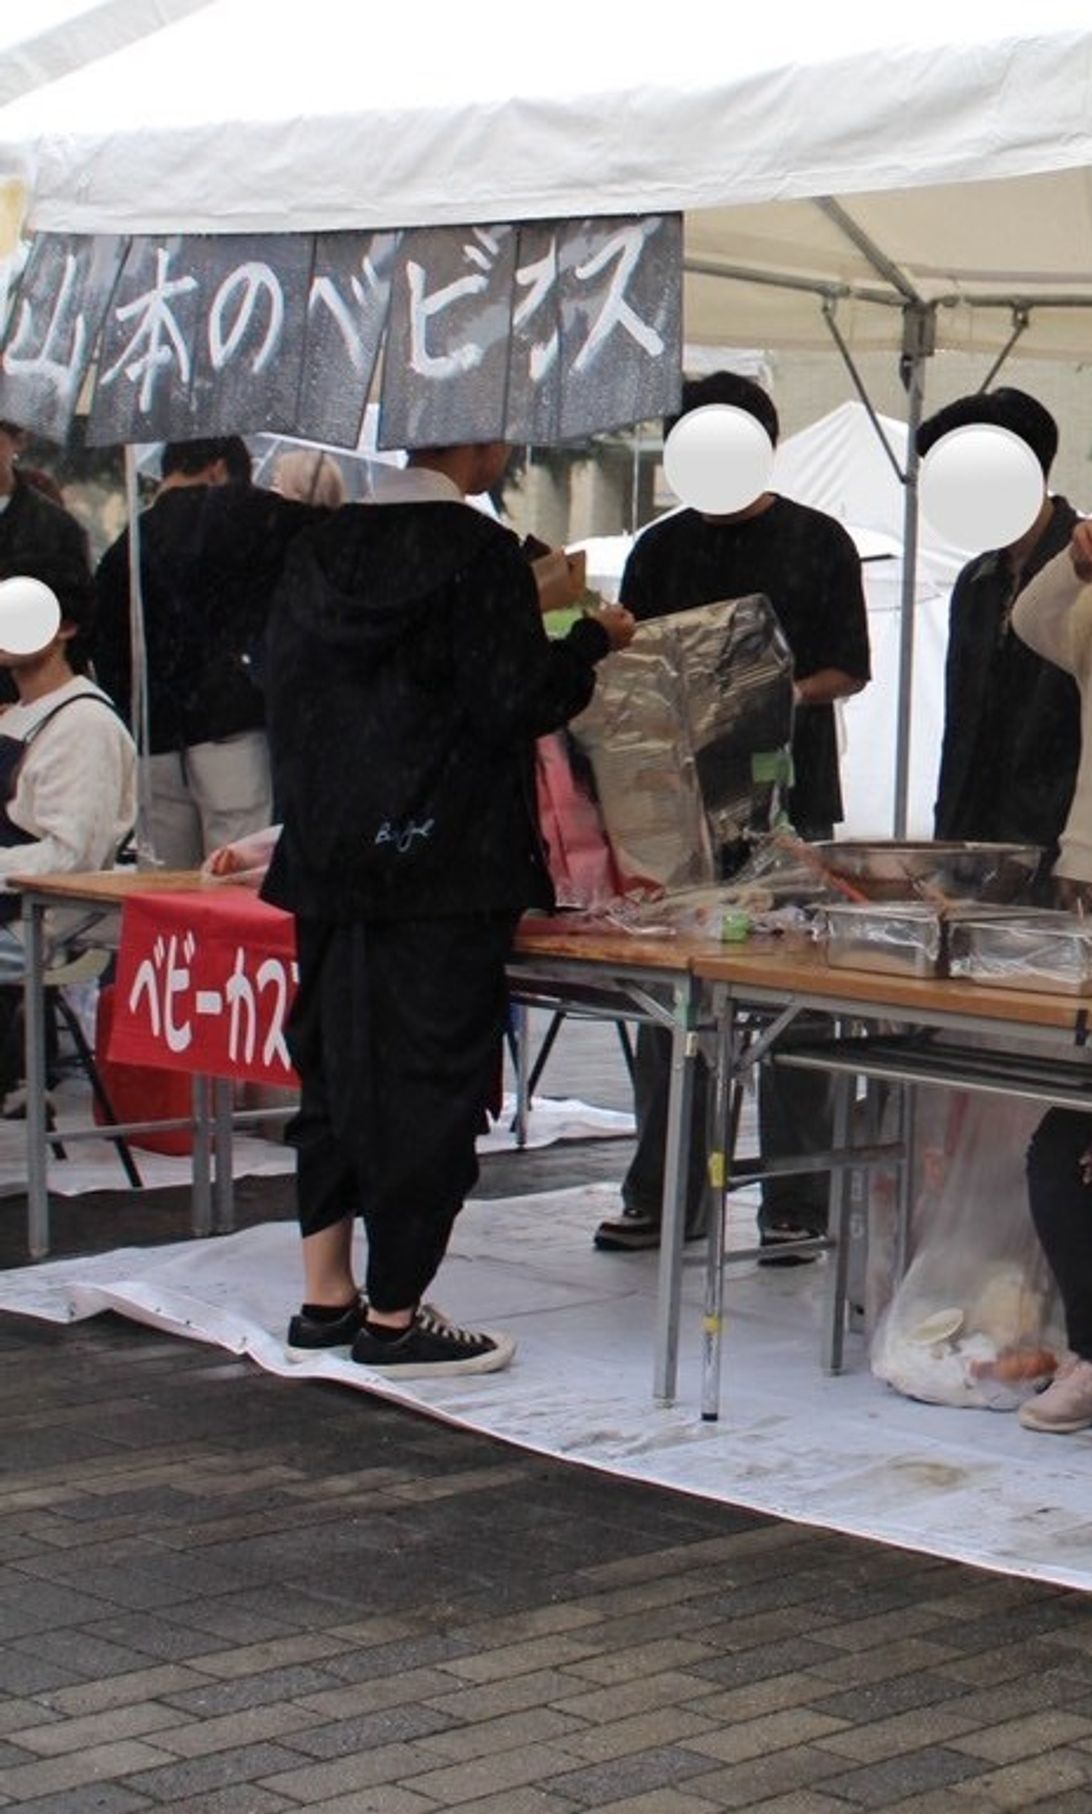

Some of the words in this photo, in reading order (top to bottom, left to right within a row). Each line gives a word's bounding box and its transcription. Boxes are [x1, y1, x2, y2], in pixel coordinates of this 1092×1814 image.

[129, 930, 299, 1072] ベビーカス
